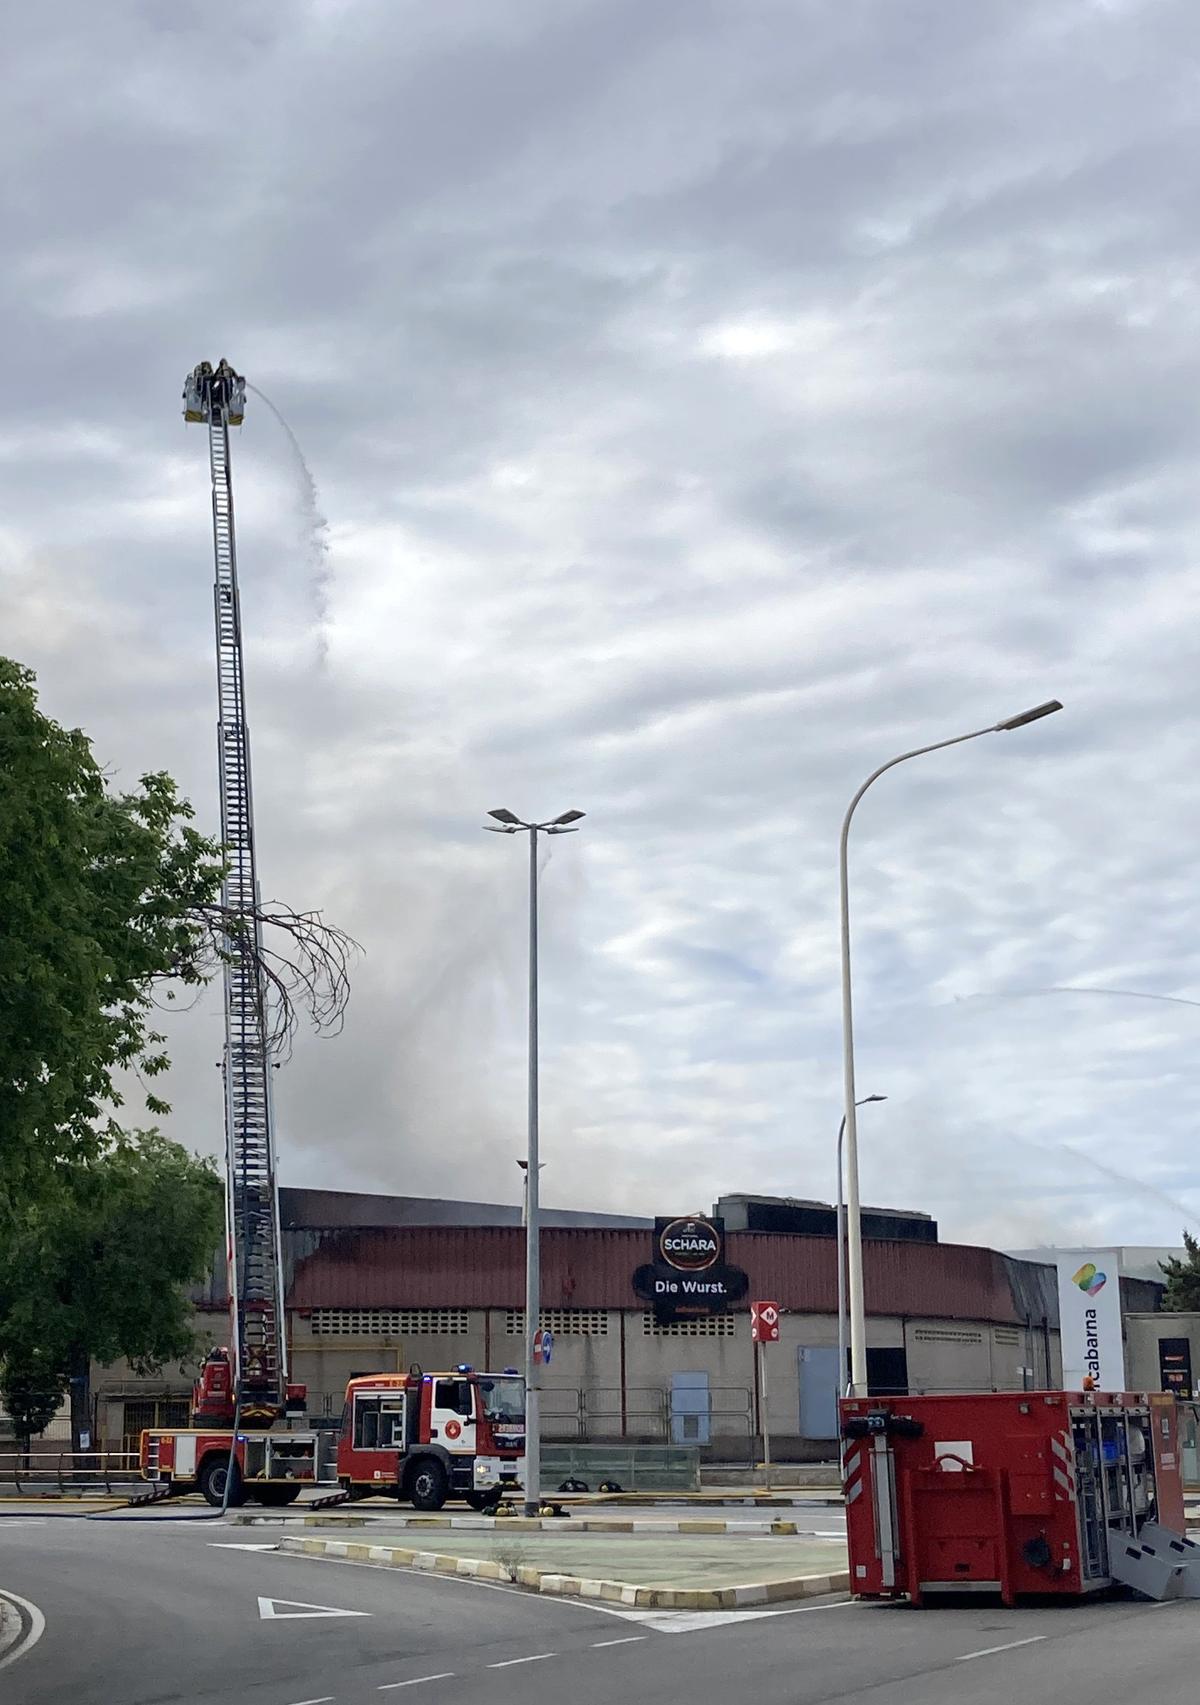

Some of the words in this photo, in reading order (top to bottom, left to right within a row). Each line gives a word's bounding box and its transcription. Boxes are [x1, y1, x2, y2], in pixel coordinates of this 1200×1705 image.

[664, 1239, 716, 1250] SCHARA
[655, 1281, 678, 1293] Die
[682, 1281, 727, 1293] Wurst.
[766, 1311, 774, 1321] M
